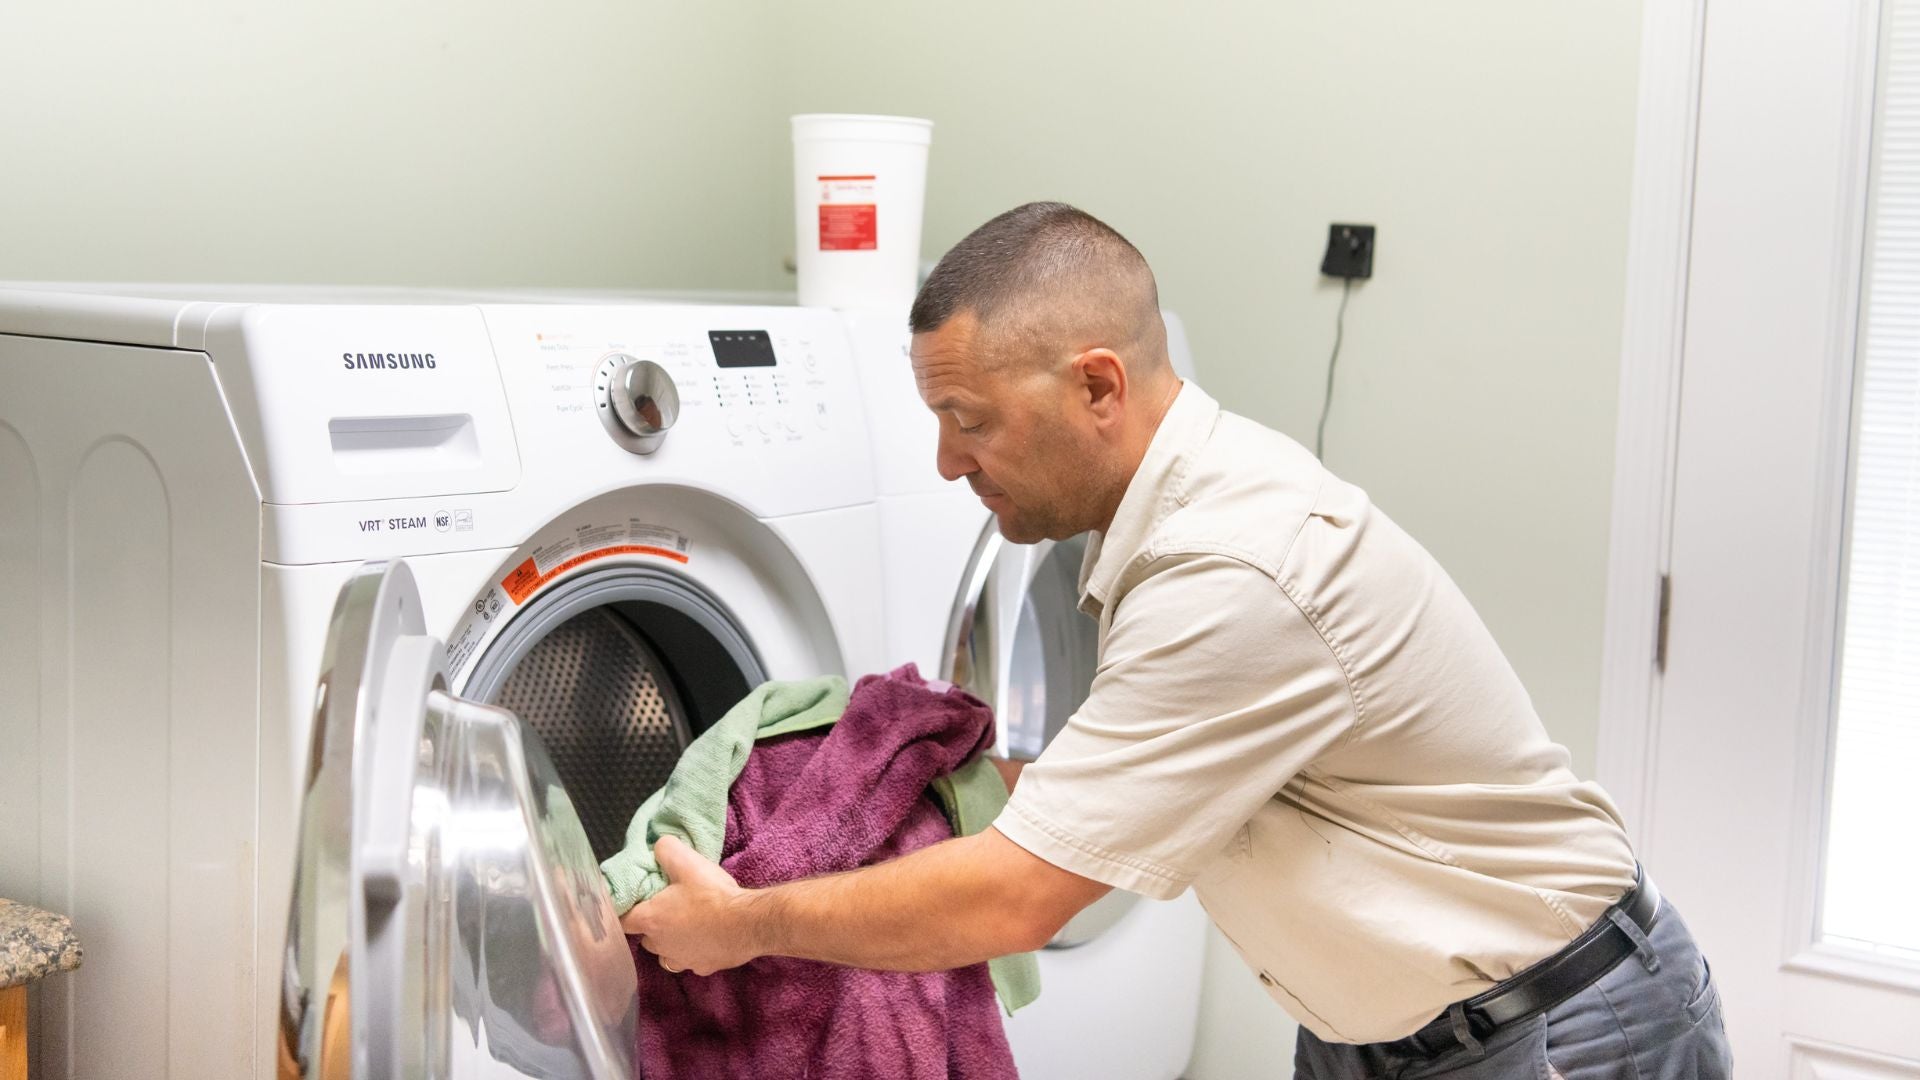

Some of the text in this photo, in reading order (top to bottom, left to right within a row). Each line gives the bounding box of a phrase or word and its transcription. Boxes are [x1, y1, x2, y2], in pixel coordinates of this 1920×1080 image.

[342, 353, 437, 370] SAMSUNG
[388, 517, 427, 530] STEAM
[436, 516, 449, 527] NSF
